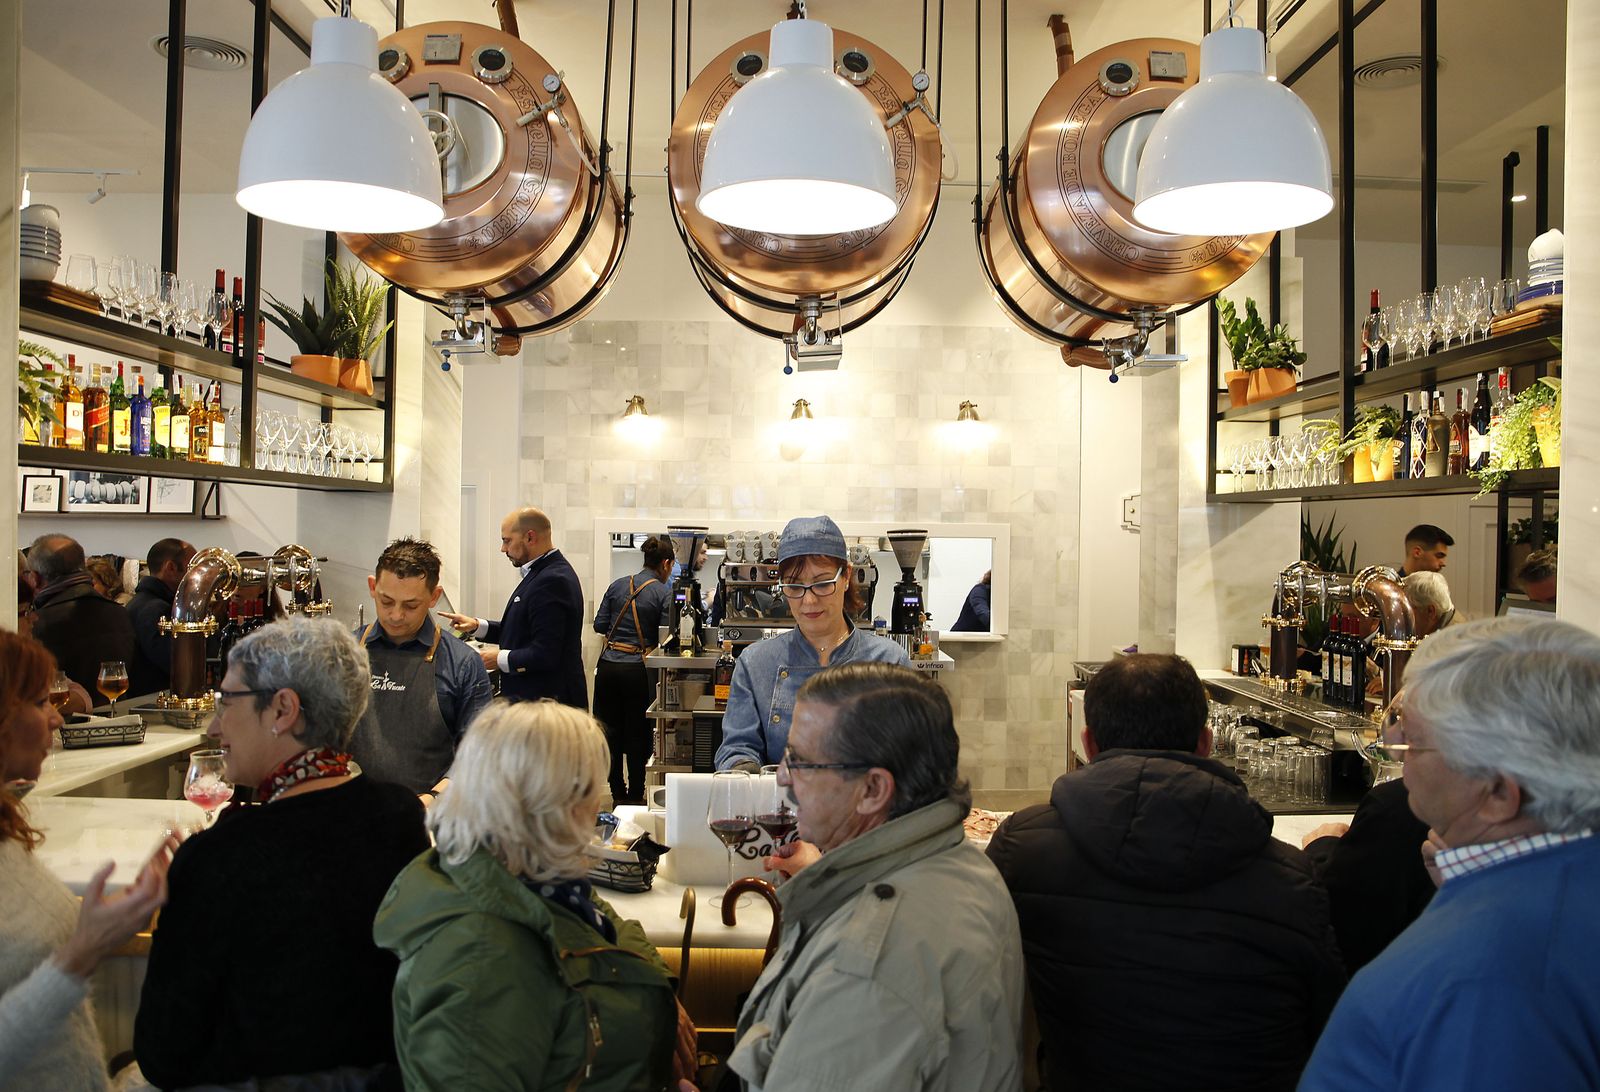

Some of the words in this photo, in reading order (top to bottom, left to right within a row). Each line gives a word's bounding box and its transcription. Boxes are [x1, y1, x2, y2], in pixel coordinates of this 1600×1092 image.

[511, 85, 548, 171] Esrella
[1062, 95, 1102, 165] BODEGA
[1064, 169, 1081, 197] DE
[1072, 194, 1140, 262] CERVEZA
[735, 826, 772, 860] La
